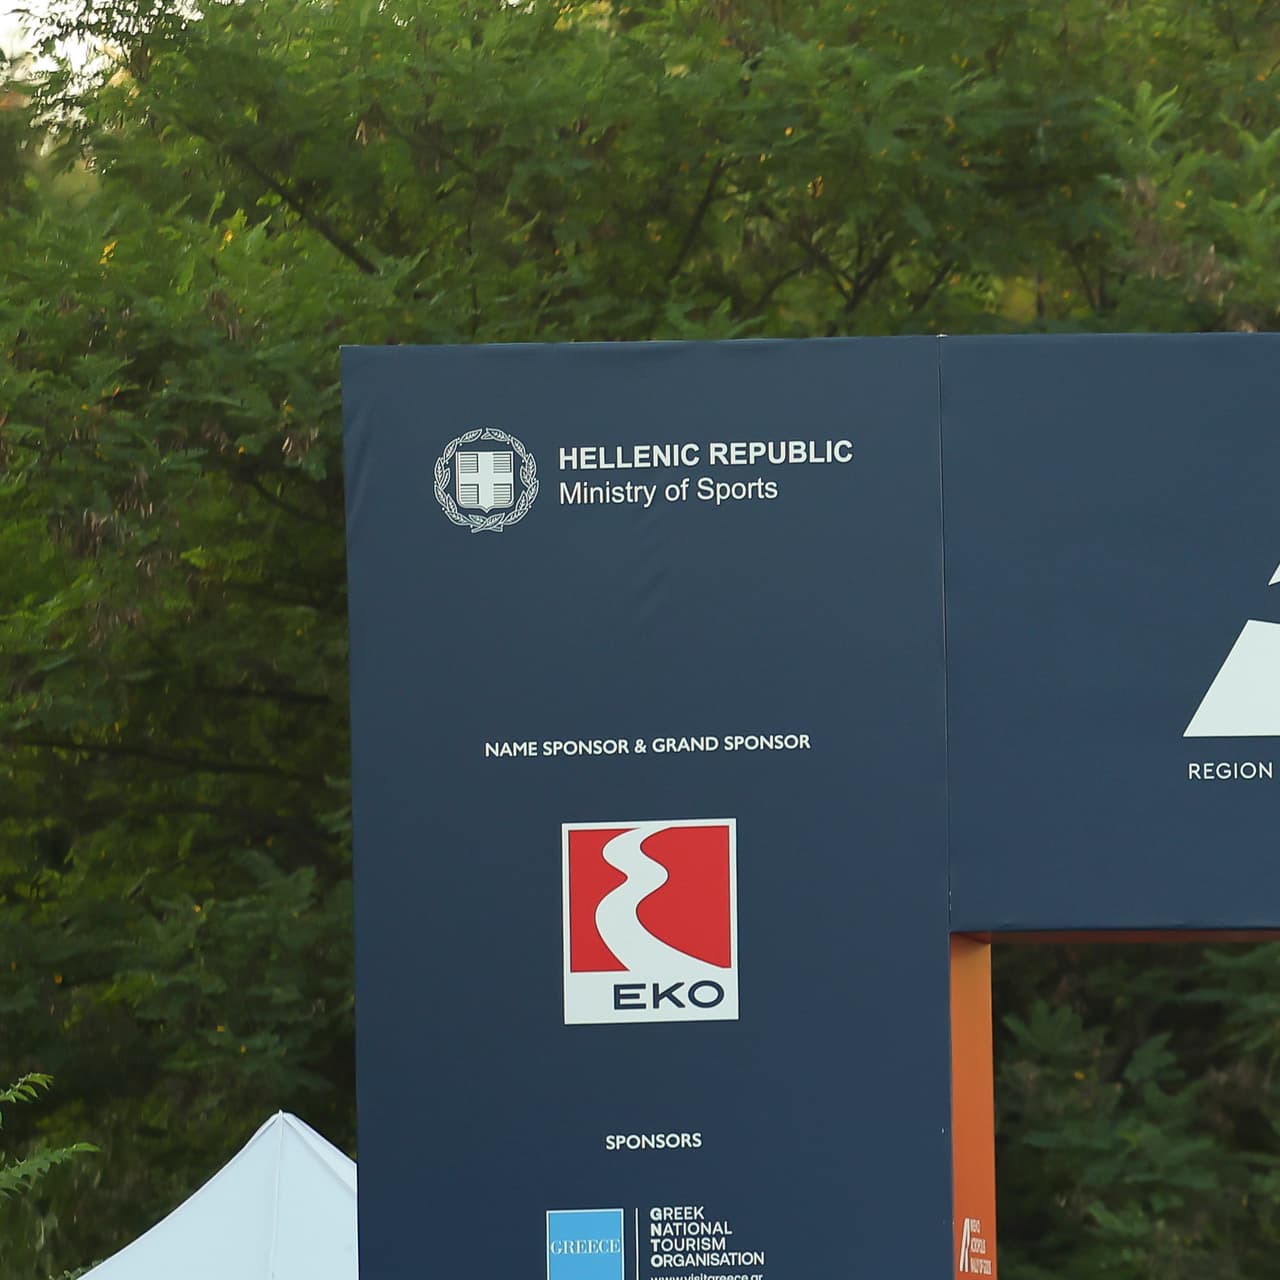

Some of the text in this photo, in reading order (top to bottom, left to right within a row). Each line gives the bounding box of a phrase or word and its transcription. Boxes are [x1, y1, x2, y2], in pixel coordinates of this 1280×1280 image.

[559, 439, 854, 470] HELLENIC REPUBLIC
[560, 477, 779, 508] Ministry of Sports
[485, 734, 811, 757] NAME SPONSOR & GRAND SPONSOR
[1188, 762, 1273, 780] REGION
[613, 979, 726, 1011] EKO
[606, 1132, 703, 1150] SPONSORS
[650, 1206, 705, 1221] GREEK
[650, 1221, 733, 1237] NATIONAL
[550, 1238, 622, 1256] GREECE
[650, 1237, 726, 1252] TOURISM
[650, 1251, 765, 1268] ORGANISATION
